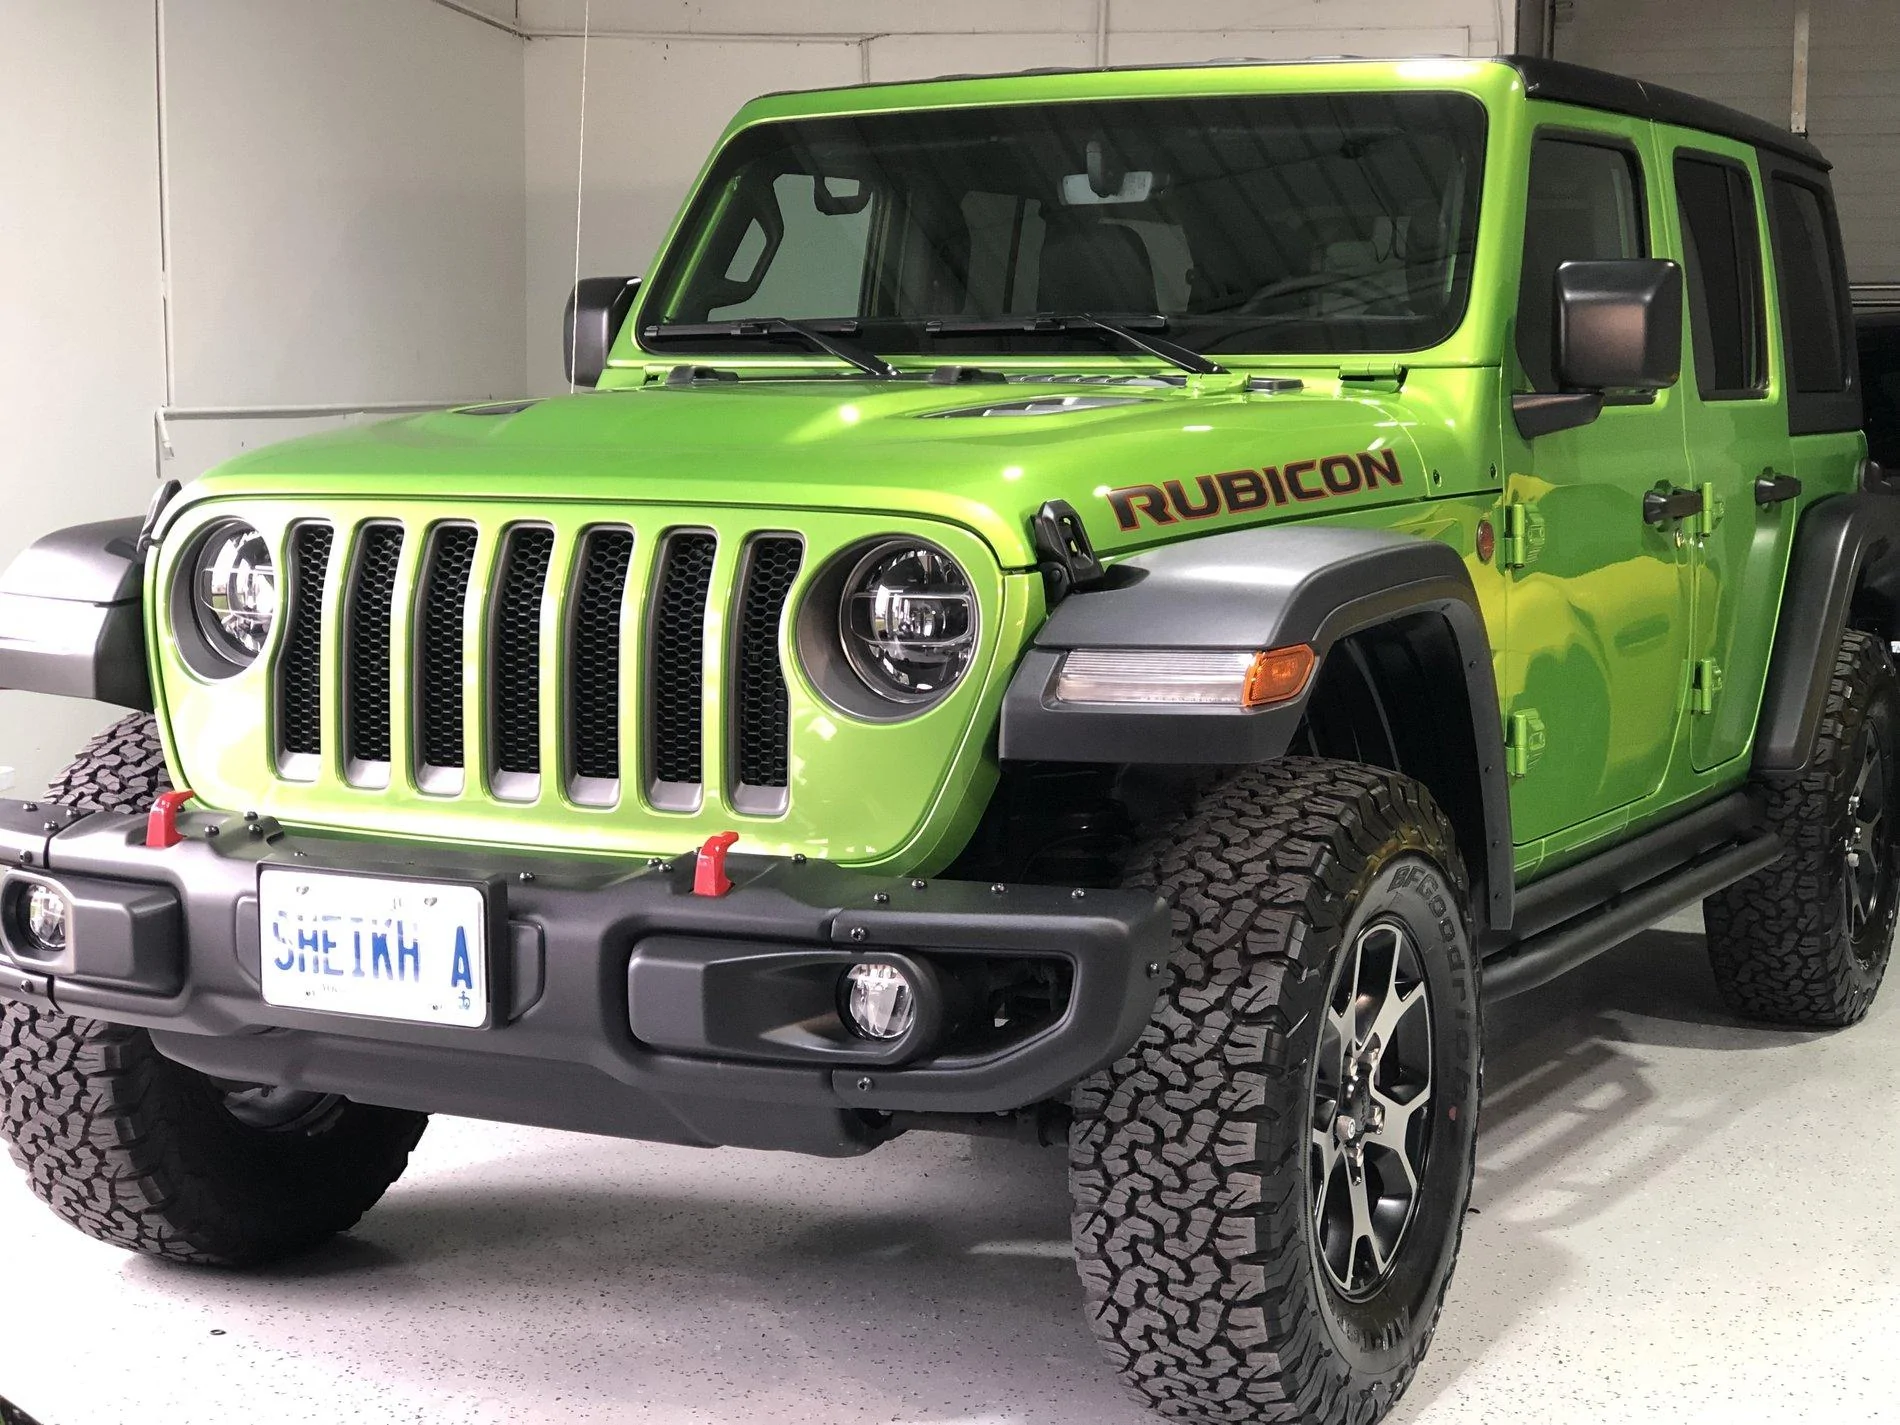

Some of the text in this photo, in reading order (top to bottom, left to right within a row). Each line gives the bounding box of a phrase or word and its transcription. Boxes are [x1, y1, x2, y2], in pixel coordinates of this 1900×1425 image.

[1106, 448, 1403, 532] RUBICON
[272, 910, 473, 990] SHEIKH A
